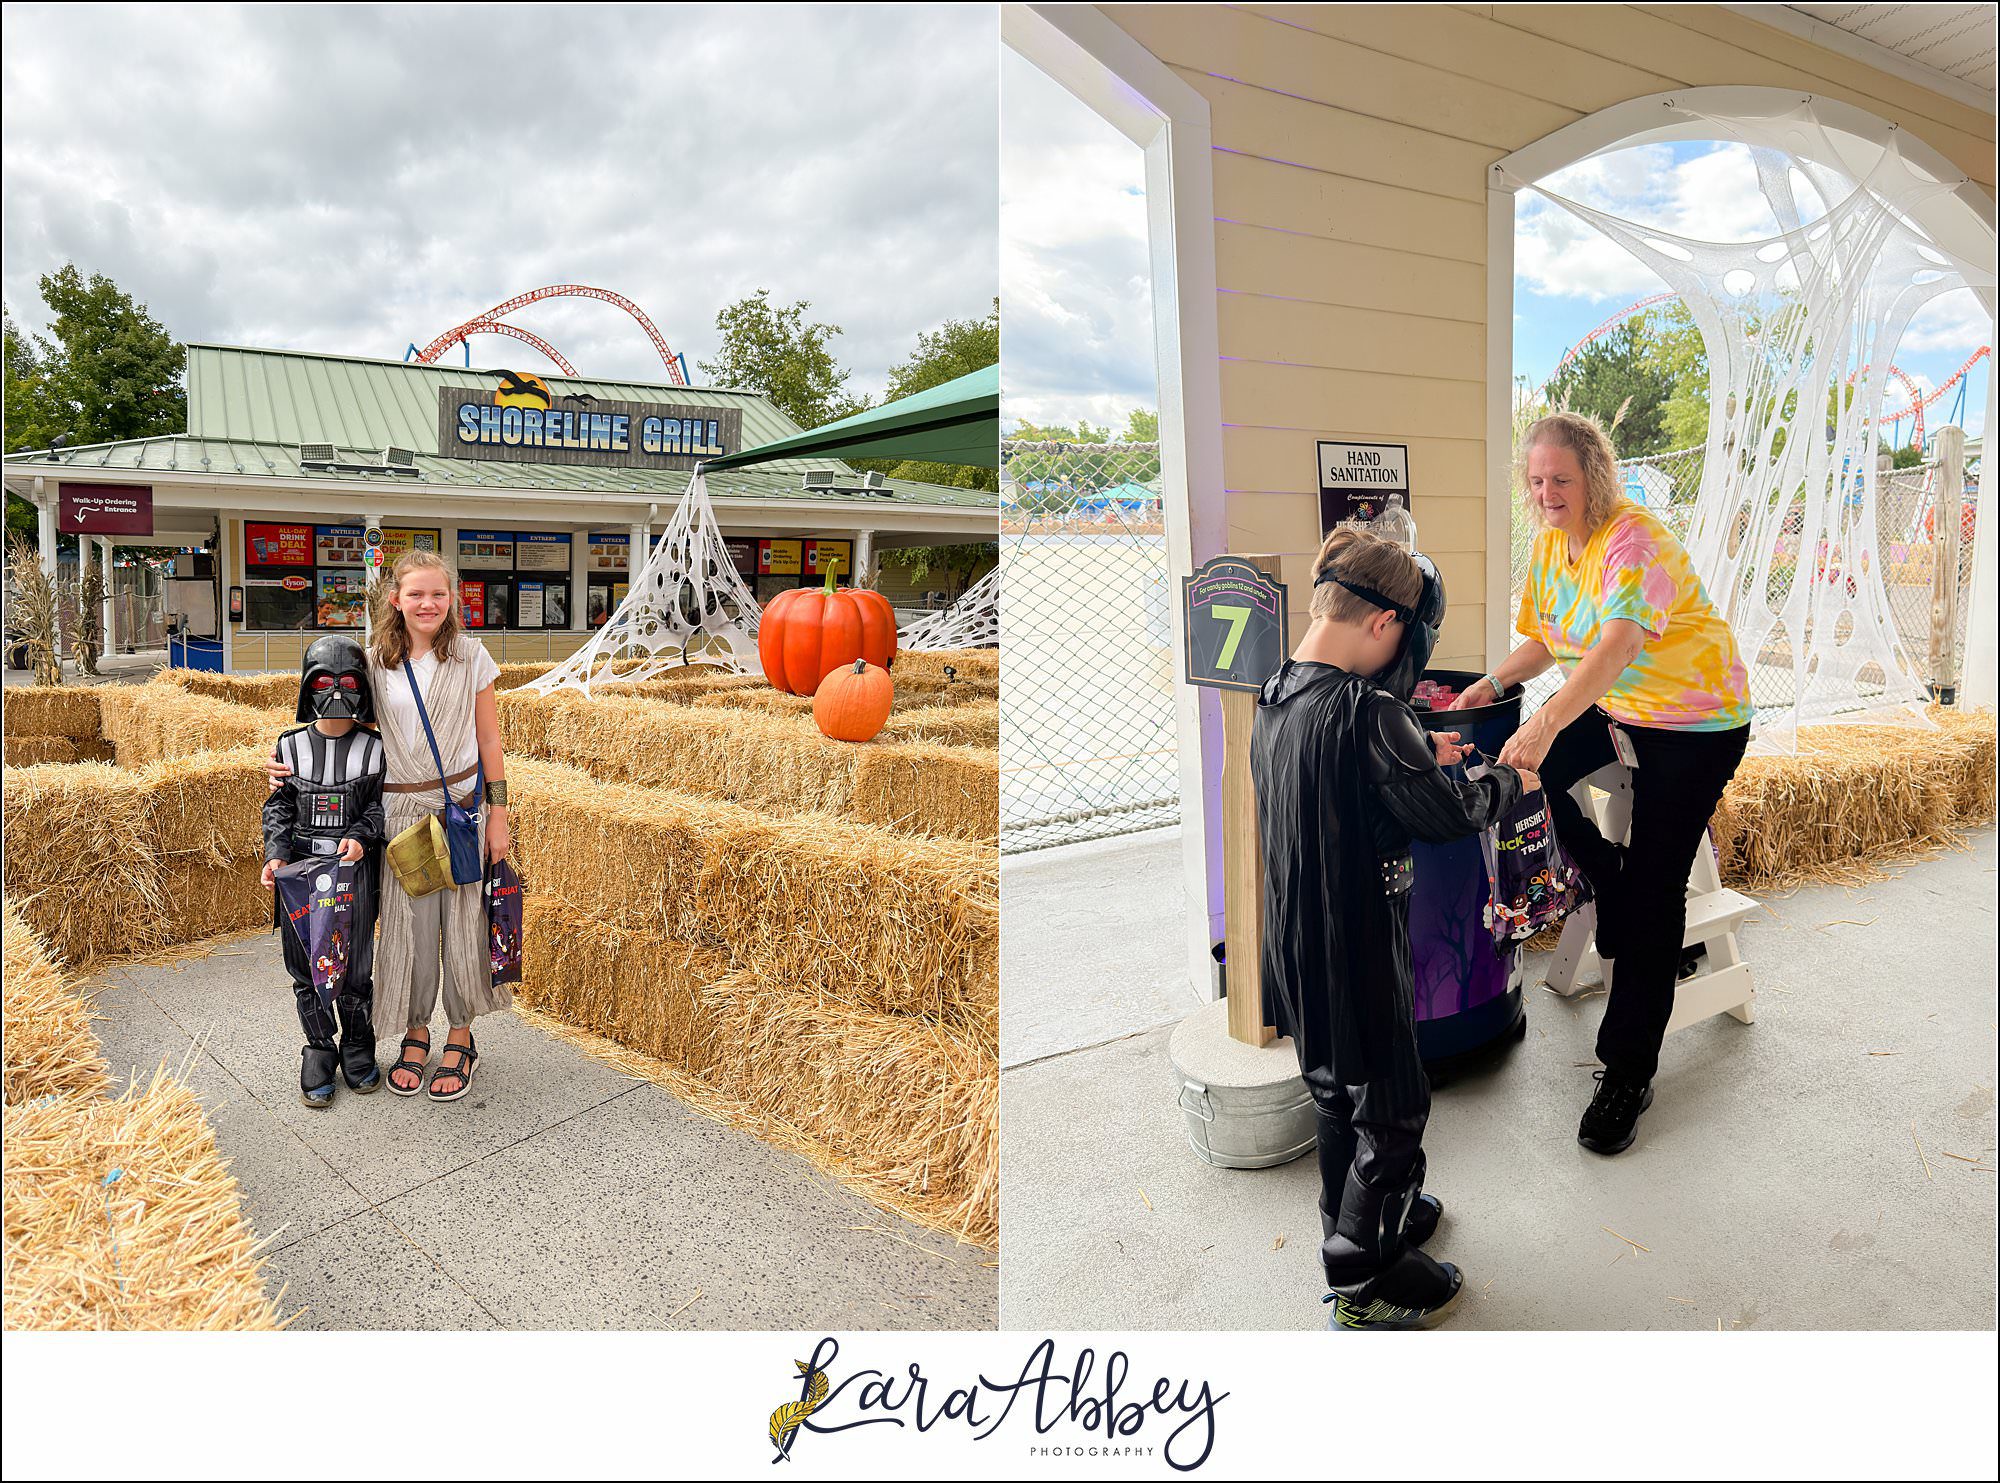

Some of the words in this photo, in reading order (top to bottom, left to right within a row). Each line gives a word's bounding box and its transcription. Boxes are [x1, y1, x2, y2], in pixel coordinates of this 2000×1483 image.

[457, 404, 631, 453] SHORELINE
[641, 416, 724, 456] GRILL
[1347, 451, 1381, 466] HAND
[1330, 467, 1398, 483] SANITATION
[72, 497, 104, 505] Walk-Up
[104, 498, 137, 507] Ordering
[280, 540, 306, 549] DEAL
[286, 580, 305, 588] Tyson
[1207, 582, 1221, 591] candy
[1222, 581, 1238, 590] goblins
[1238, 582, 1244, 590] 12
[1244, 585, 1254, 593] and
[1253, 589, 1267, 600] under
[1211, 604, 1252, 670] 7
[1515, 808, 1545, 833] HERSHEY
[1526, 829, 1541, 840] OR
